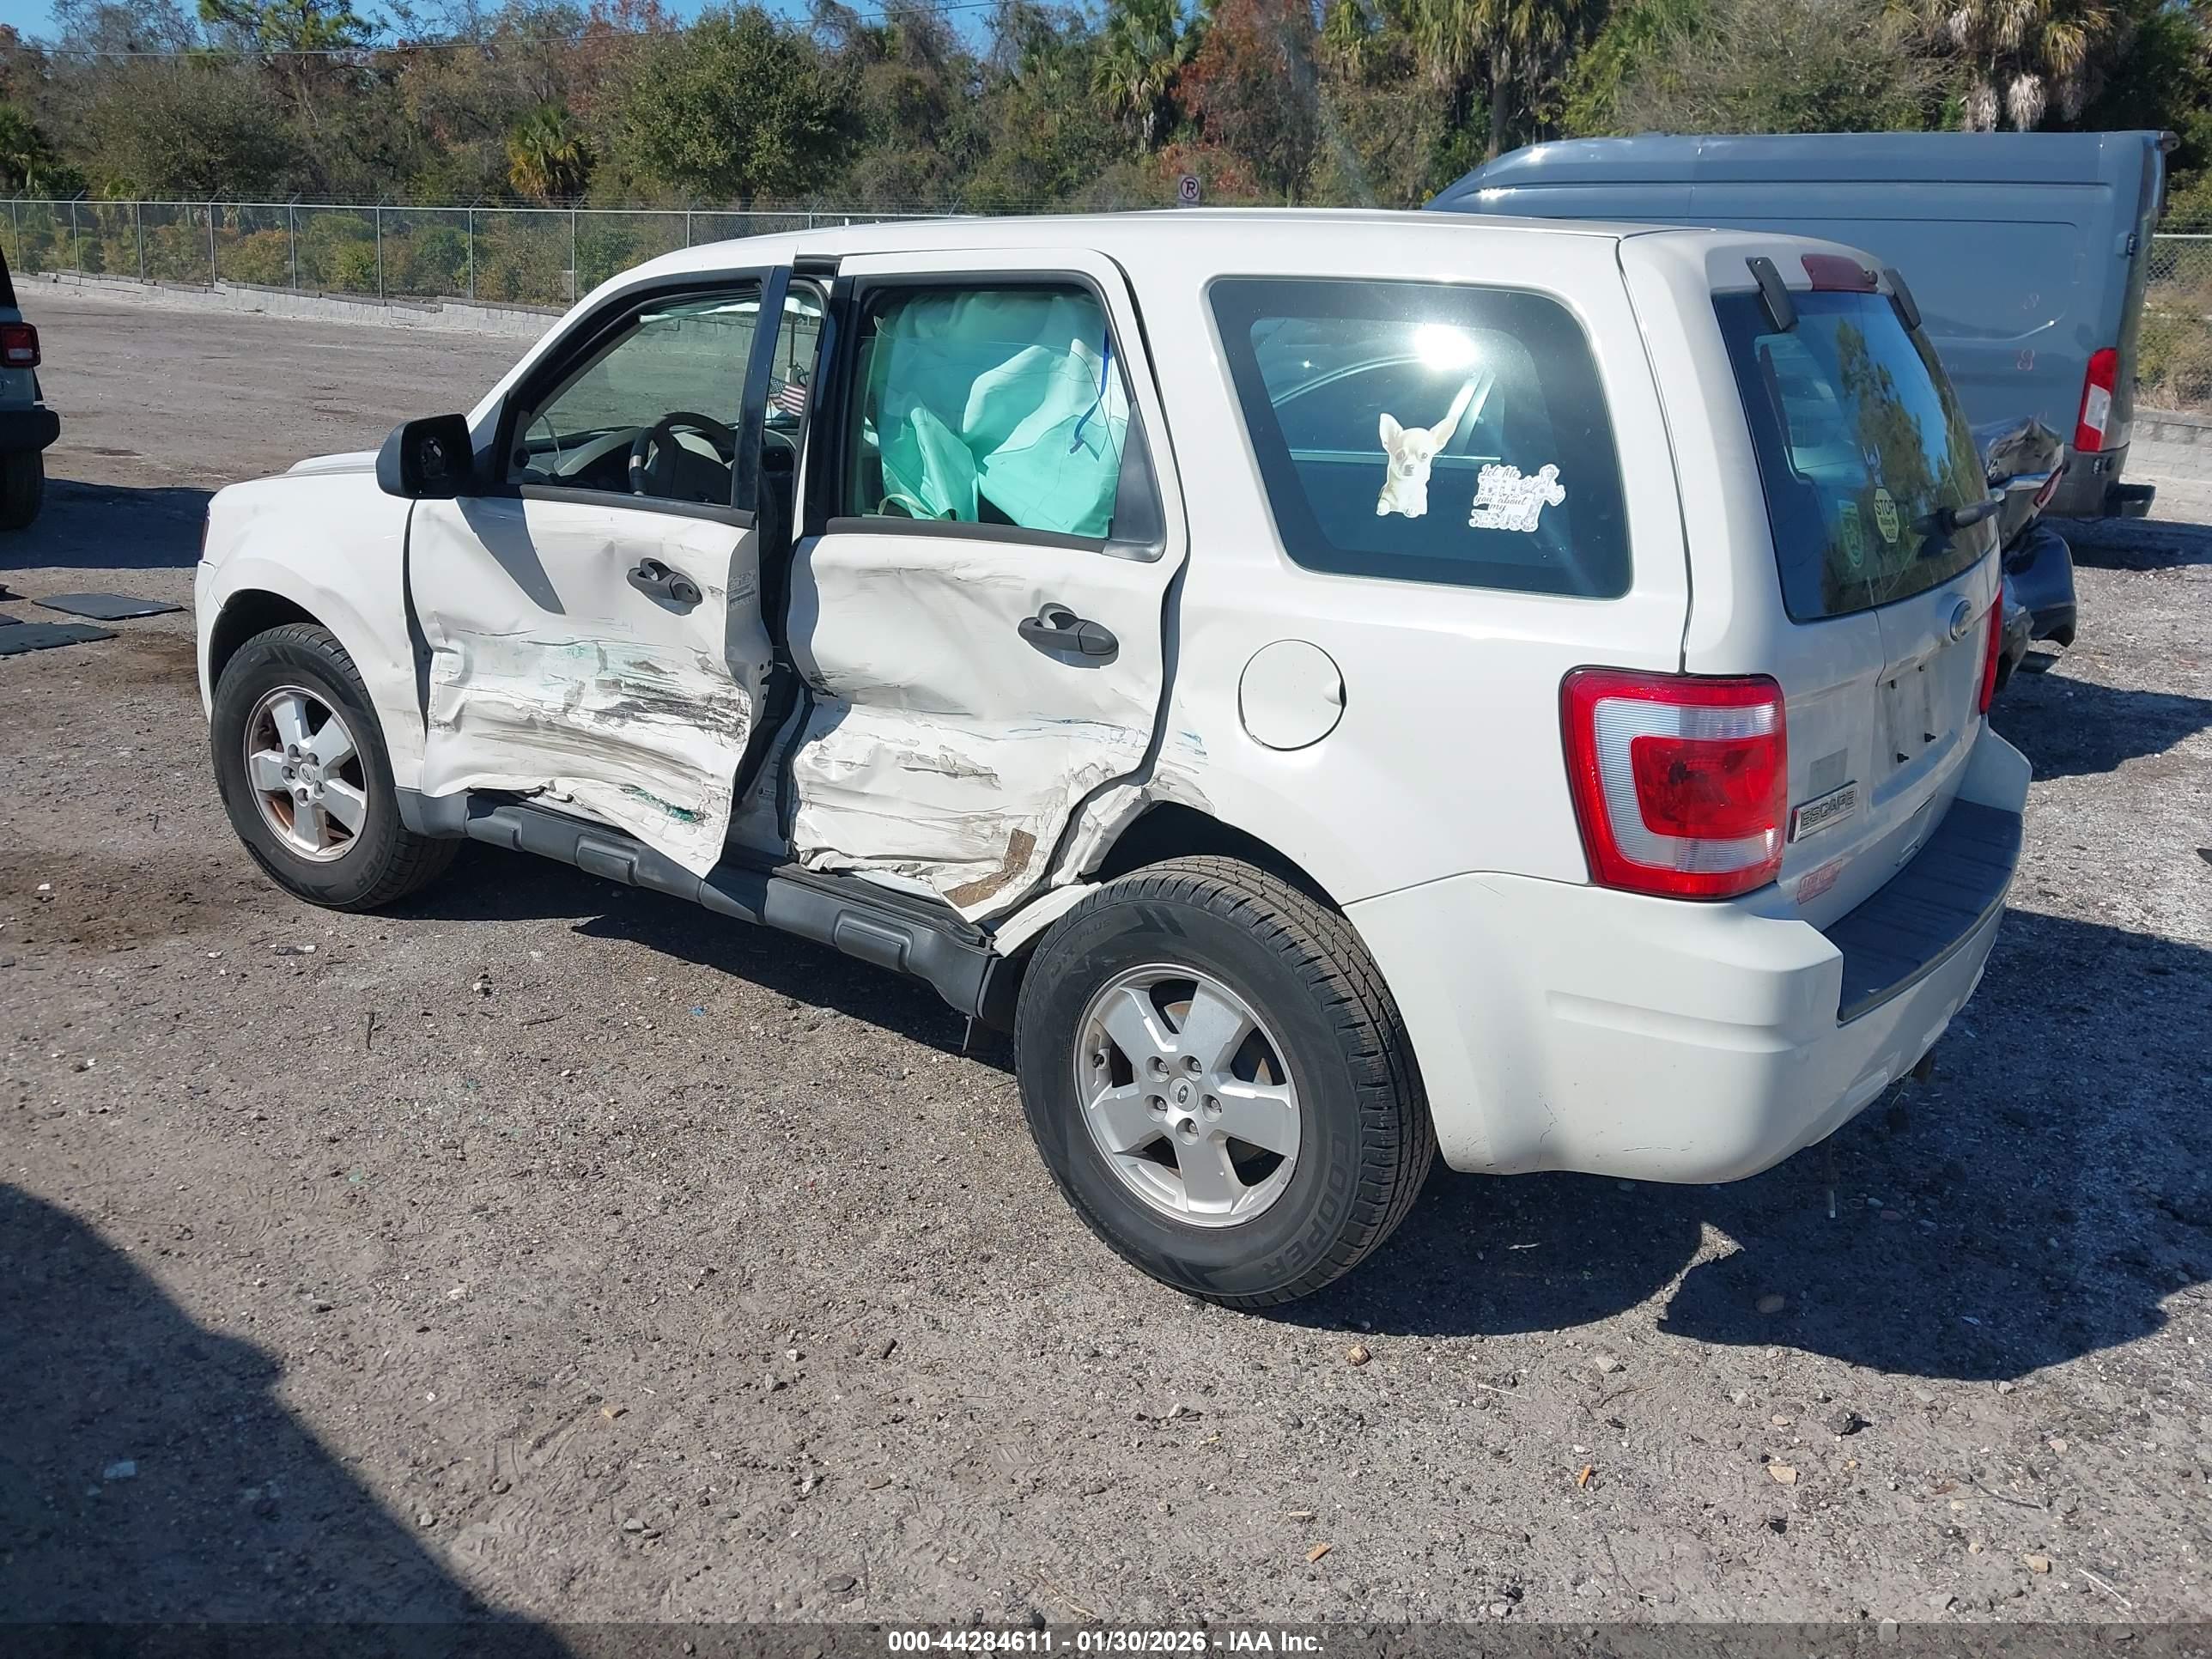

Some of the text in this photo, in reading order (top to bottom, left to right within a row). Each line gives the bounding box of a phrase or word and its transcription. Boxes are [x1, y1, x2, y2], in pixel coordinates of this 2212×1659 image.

[1475, 495, 1528, 506] you about
[1490, 503, 1506, 514] my
[1875, 499, 1895, 516] STOP
[1801, 789, 1856, 827] ESCAPE
[1263, 1132, 1349, 1279] COOPER
